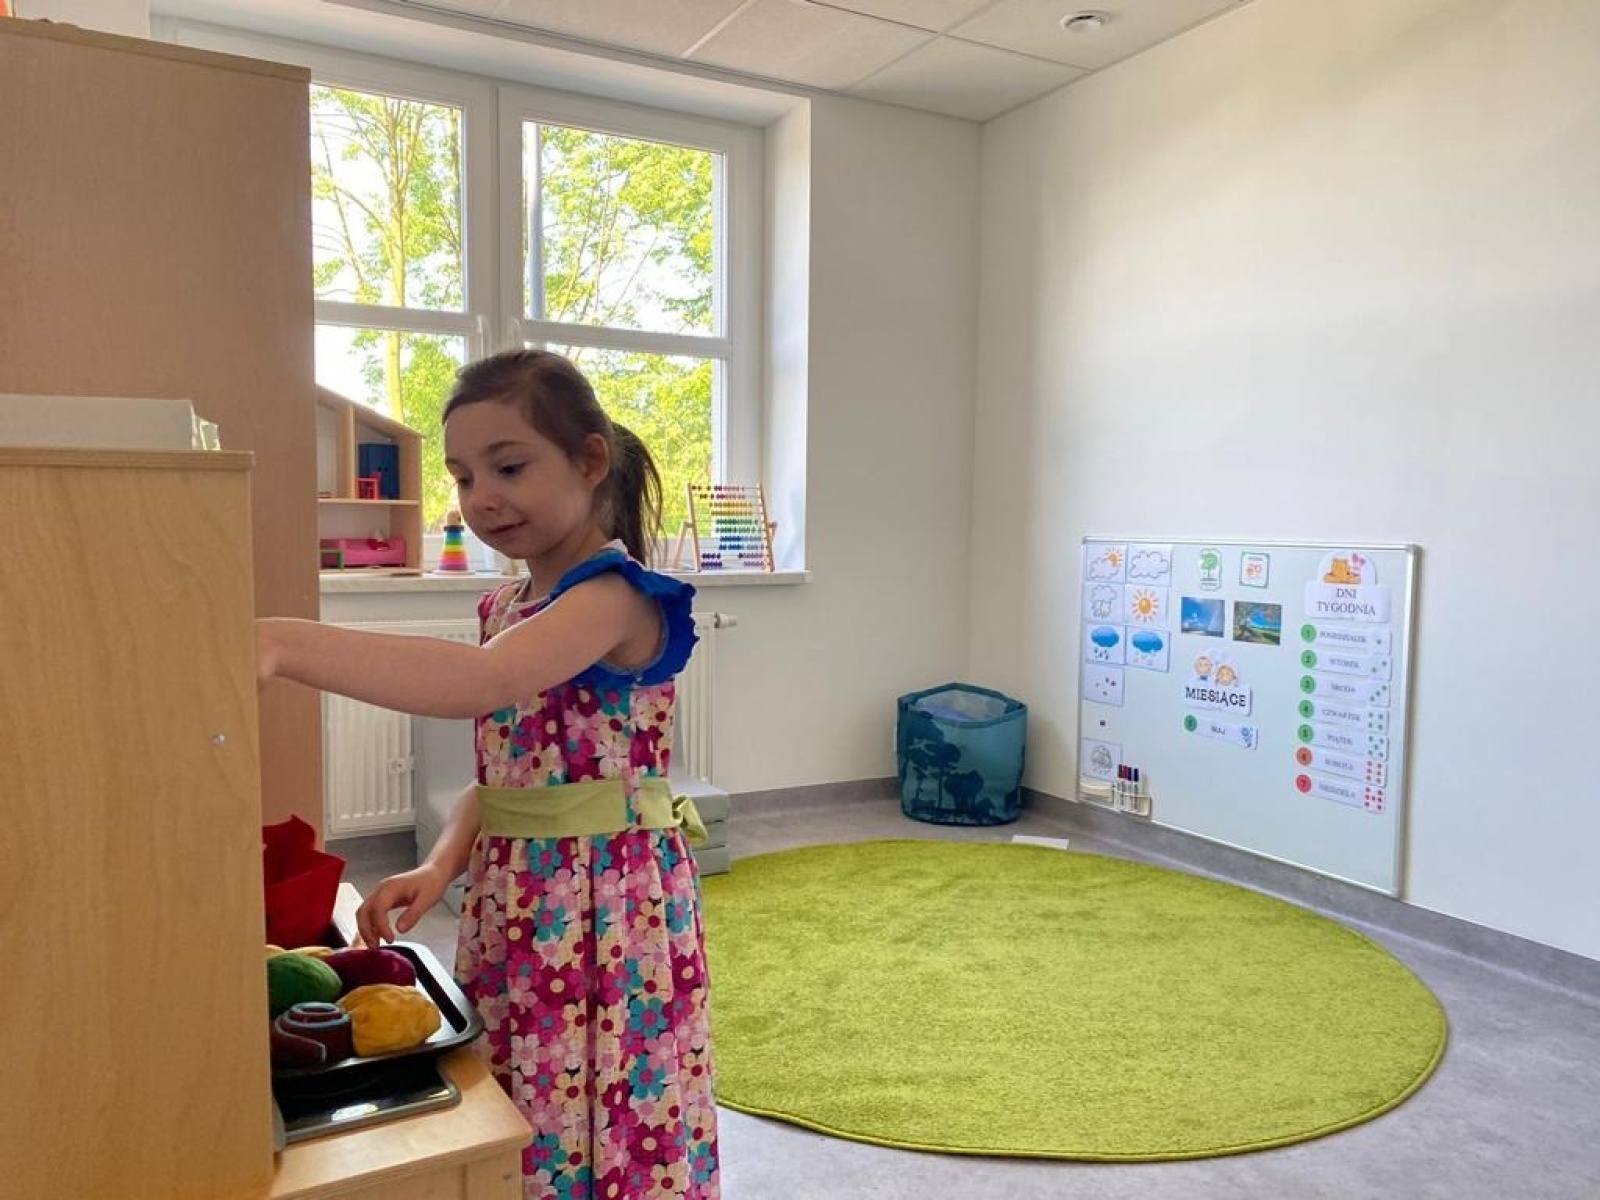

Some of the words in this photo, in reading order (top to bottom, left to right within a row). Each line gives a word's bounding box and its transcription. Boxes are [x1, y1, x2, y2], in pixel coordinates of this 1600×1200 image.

[1336, 588, 1357, 599] DNI
[1316, 601, 1376, 616] TYGODNIA
[1185, 686, 1246, 706] MIESIĄCE
